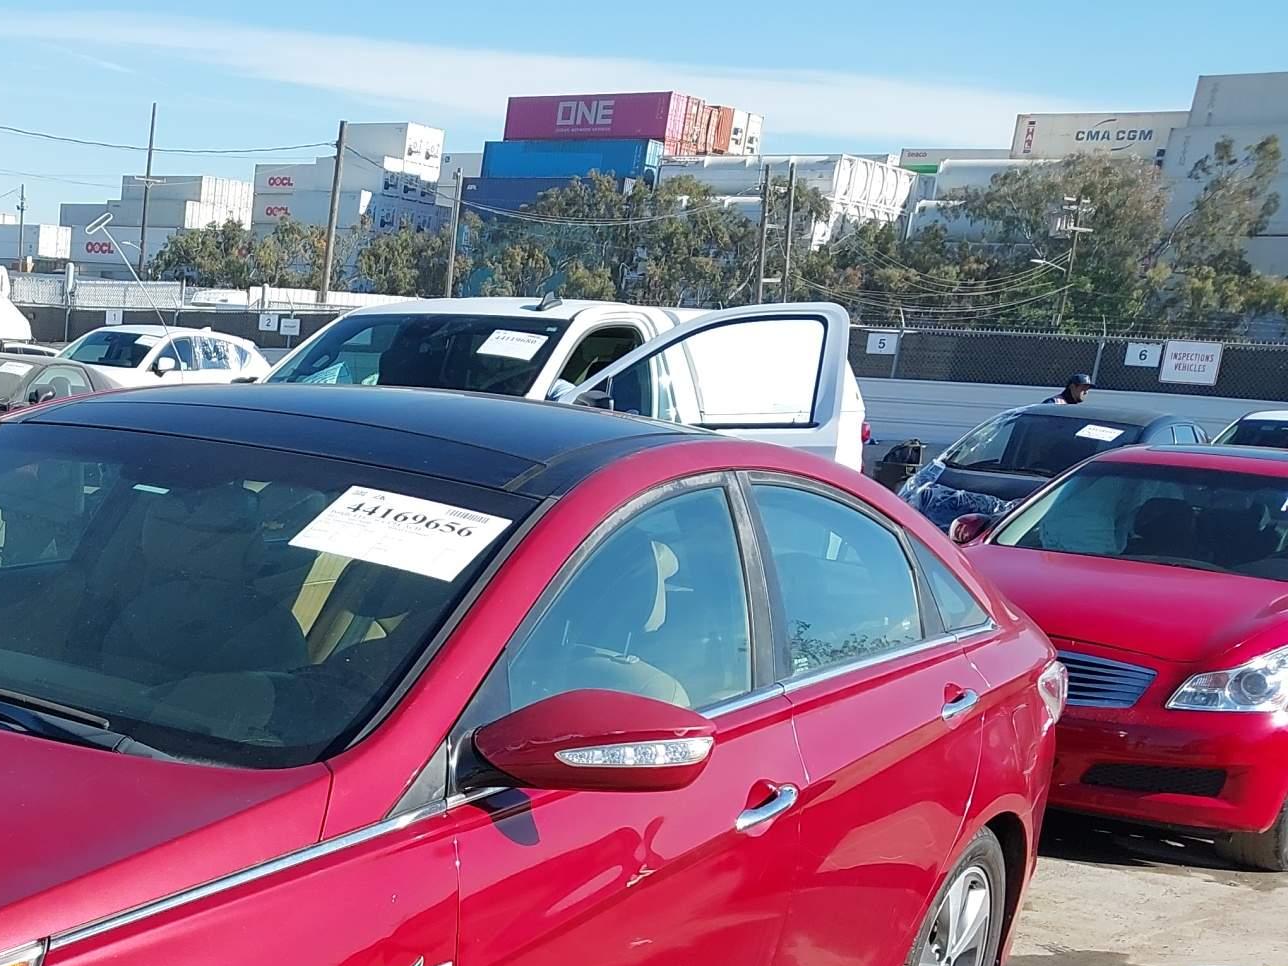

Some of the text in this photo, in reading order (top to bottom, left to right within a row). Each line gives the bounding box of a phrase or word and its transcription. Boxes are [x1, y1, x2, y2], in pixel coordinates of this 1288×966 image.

[556, 100, 615, 125] ONE
[1075, 130, 1153, 141] CMA CGM
[268, 176, 293, 187] OOCL
[85, 241, 114, 255] OOCL
[265, 318, 272, 327] 2
[878, 338, 886, 349] 5
[1139, 349, 1148, 361] 6
[1171, 351, 1215, 363] INSPECTIONS
[1174, 362, 1207, 373] VEHICLES
[346, 502, 475, 538] 44169656
